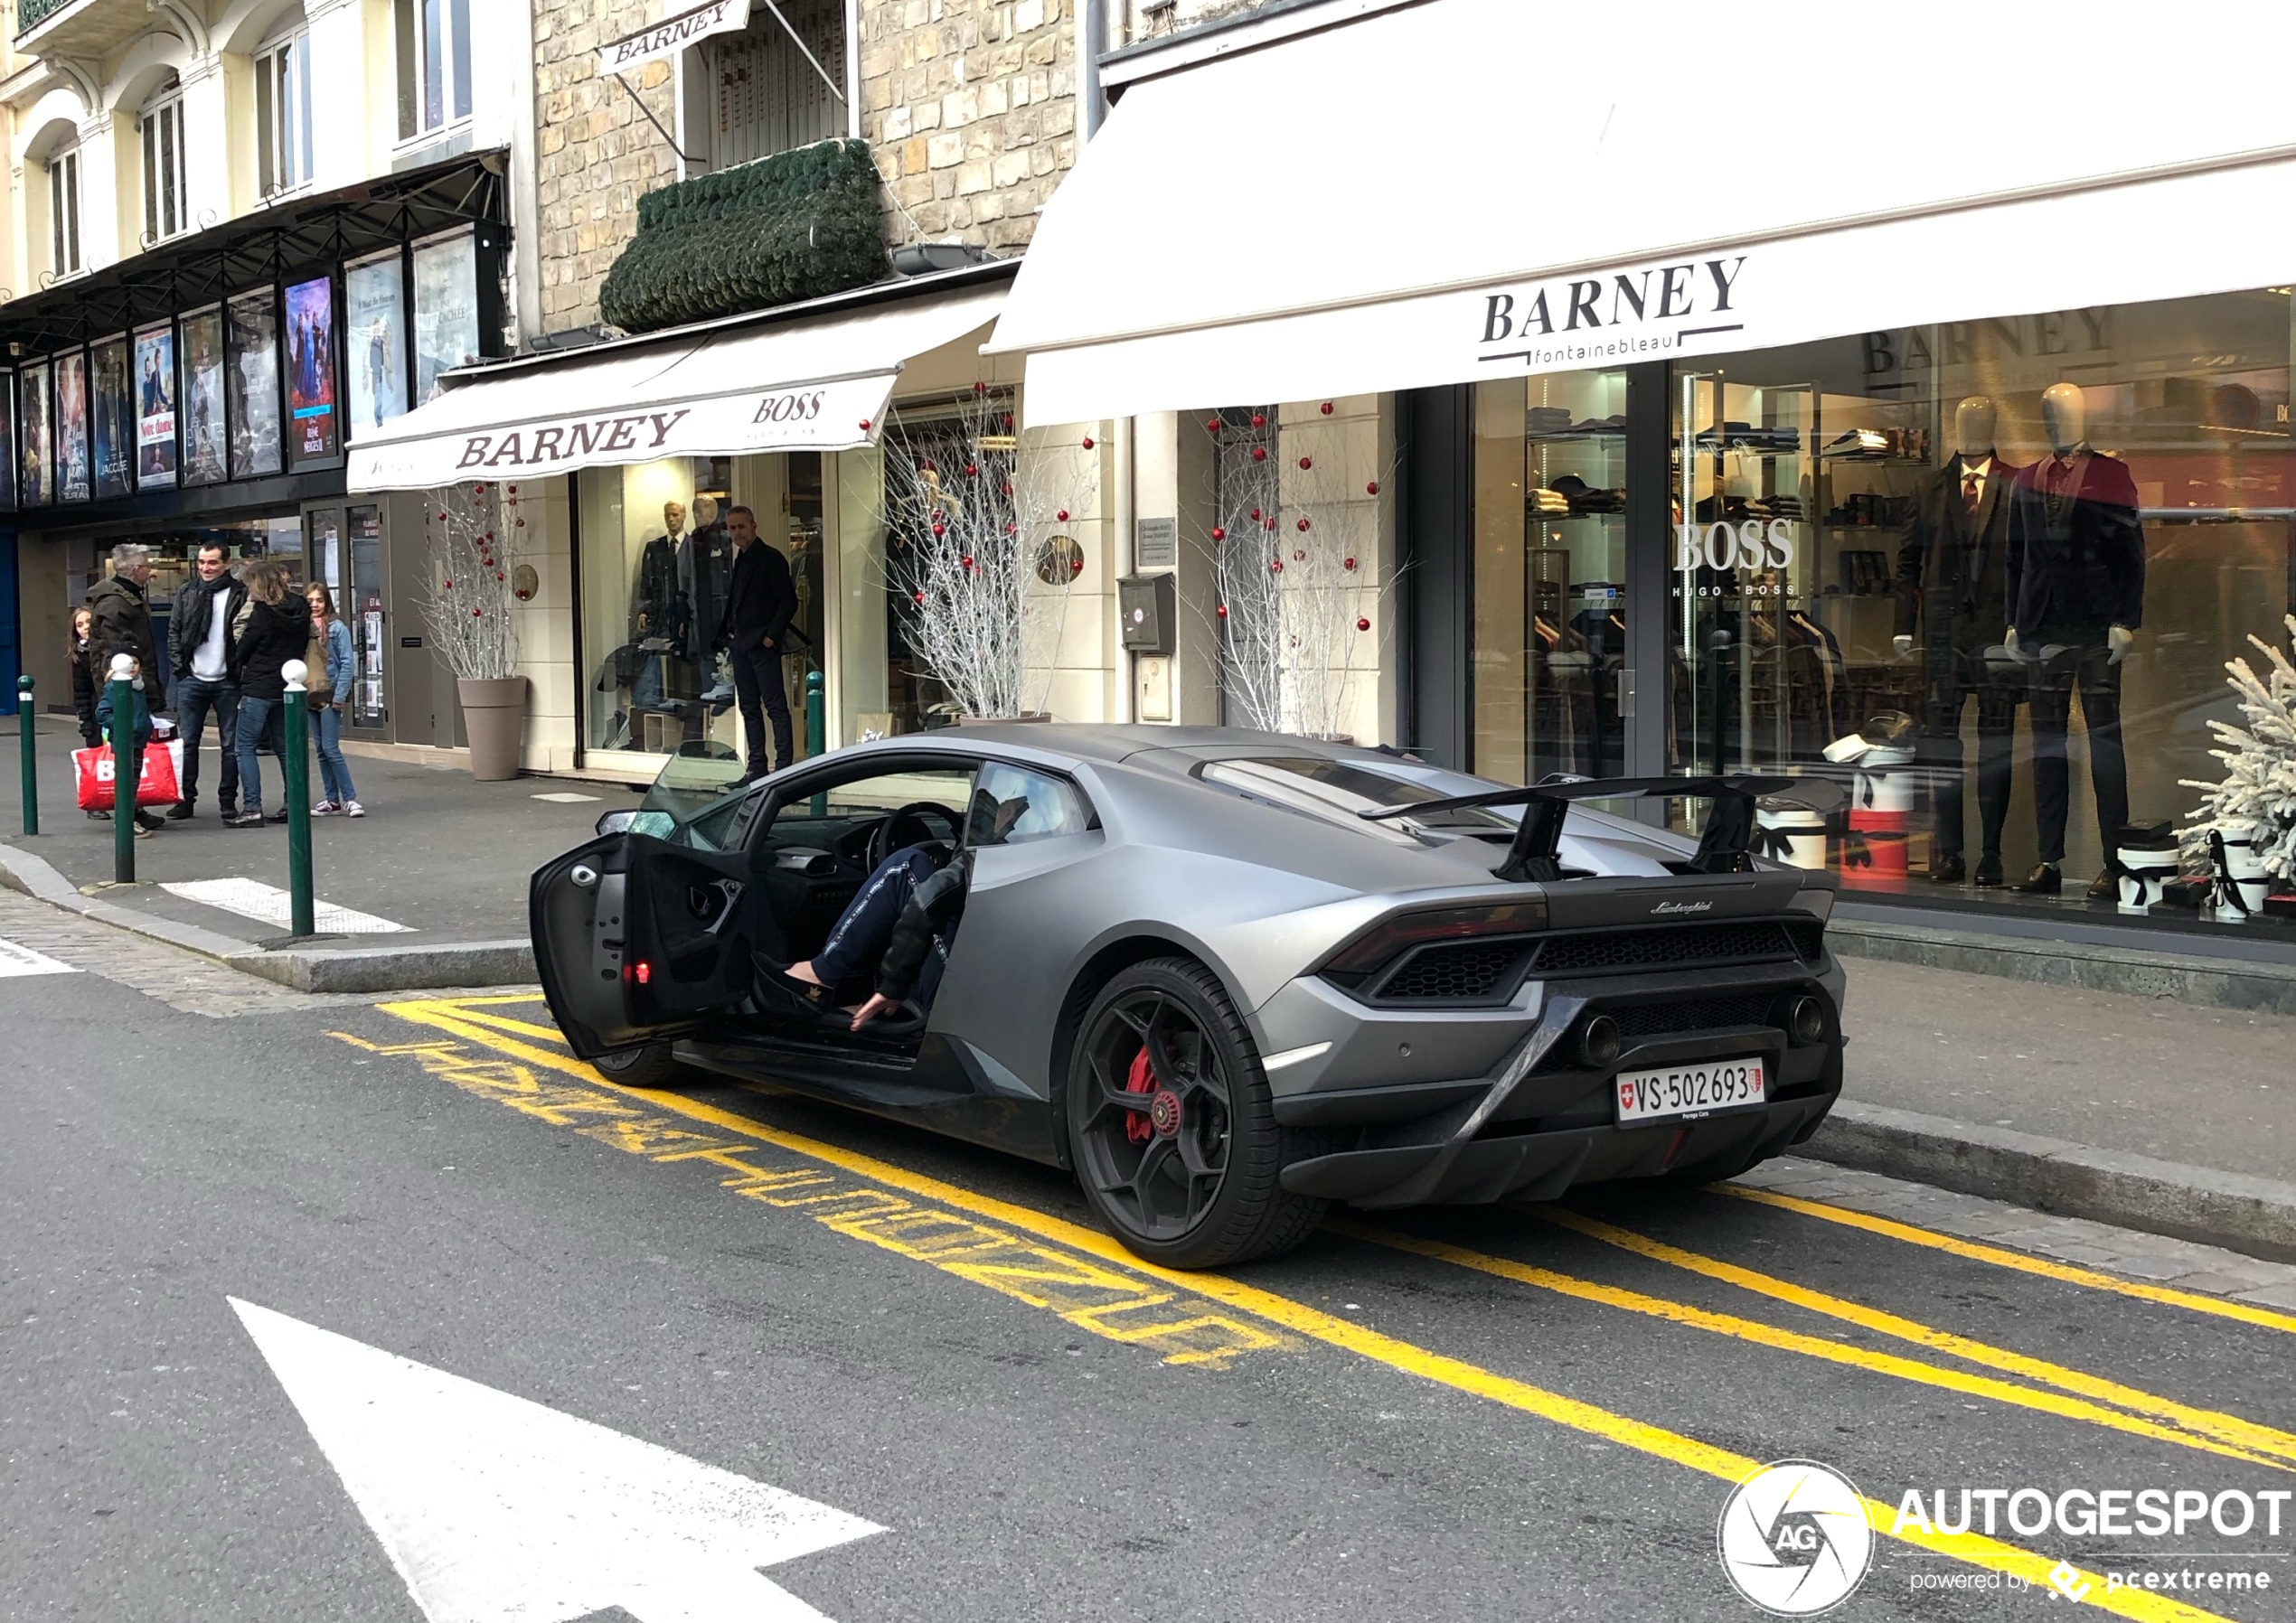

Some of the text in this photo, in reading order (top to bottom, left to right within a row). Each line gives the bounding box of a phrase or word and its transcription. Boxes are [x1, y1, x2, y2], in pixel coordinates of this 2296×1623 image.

[615, 0, 731, 64] BARNEY
[1480, 257, 1747, 342] BARNEY
[438, 305, 465, 324] CACHÉE
[1536, 337, 1672, 363] fontainebleau
[750, 391, 825, 424] BOSS
[141, 418, 174, 438] Notre dame
[456, 409, 691, 469] BARNEY
[1672, 518, 1793, 571] BOSS
[1672, 585, 1794, 596] HUGO BOSS
[1650, 901, 1713, 915] Lamborghini
